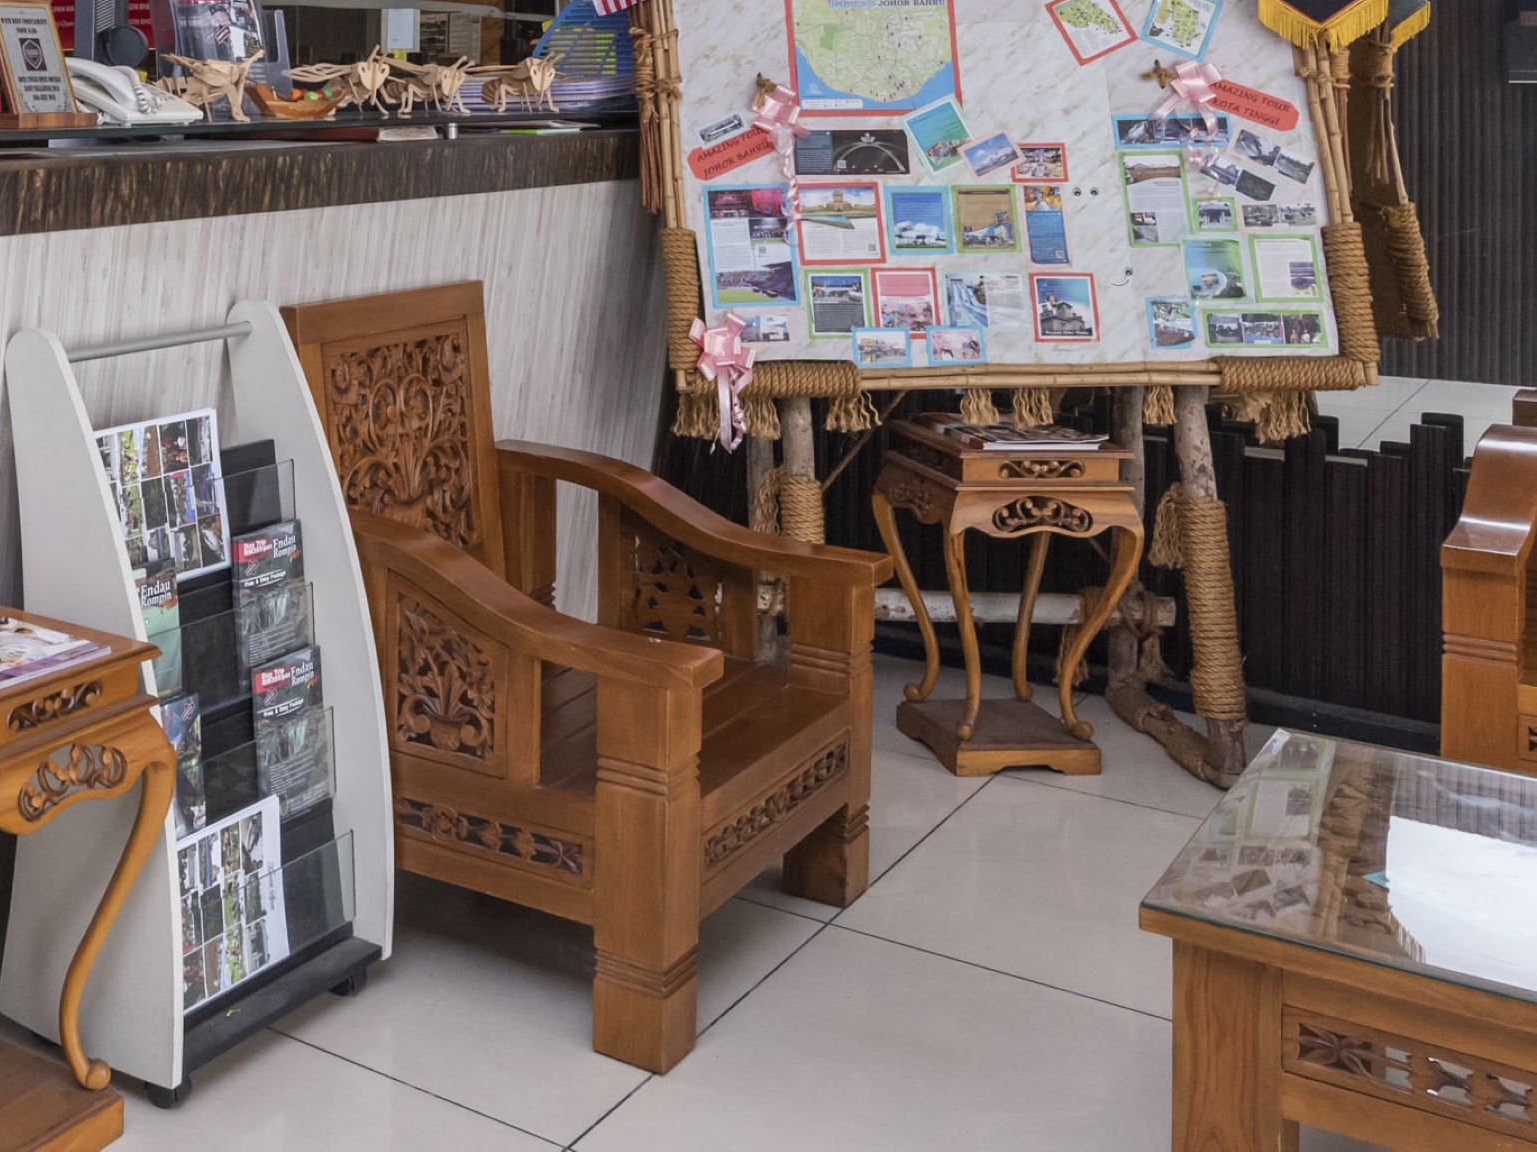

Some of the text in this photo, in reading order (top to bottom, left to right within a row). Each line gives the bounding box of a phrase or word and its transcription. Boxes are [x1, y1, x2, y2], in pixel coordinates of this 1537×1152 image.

[878, 0, 910, 7] JOHOR
[1213, 82, 1291, 113] AMAZING TOUR
[1212, 97, 1281, 126] KOTA TINGGI
[697, 128, 763, 163] AMAZING TOU
[703, 140, 770, 177] JOHOR BAHRU
[273, 535, 296, 549] Endau
[141, 580, 171, 597] Endau
[140, 592, 172, 608] Rompin
[291, 661, 314, 676] Endau
